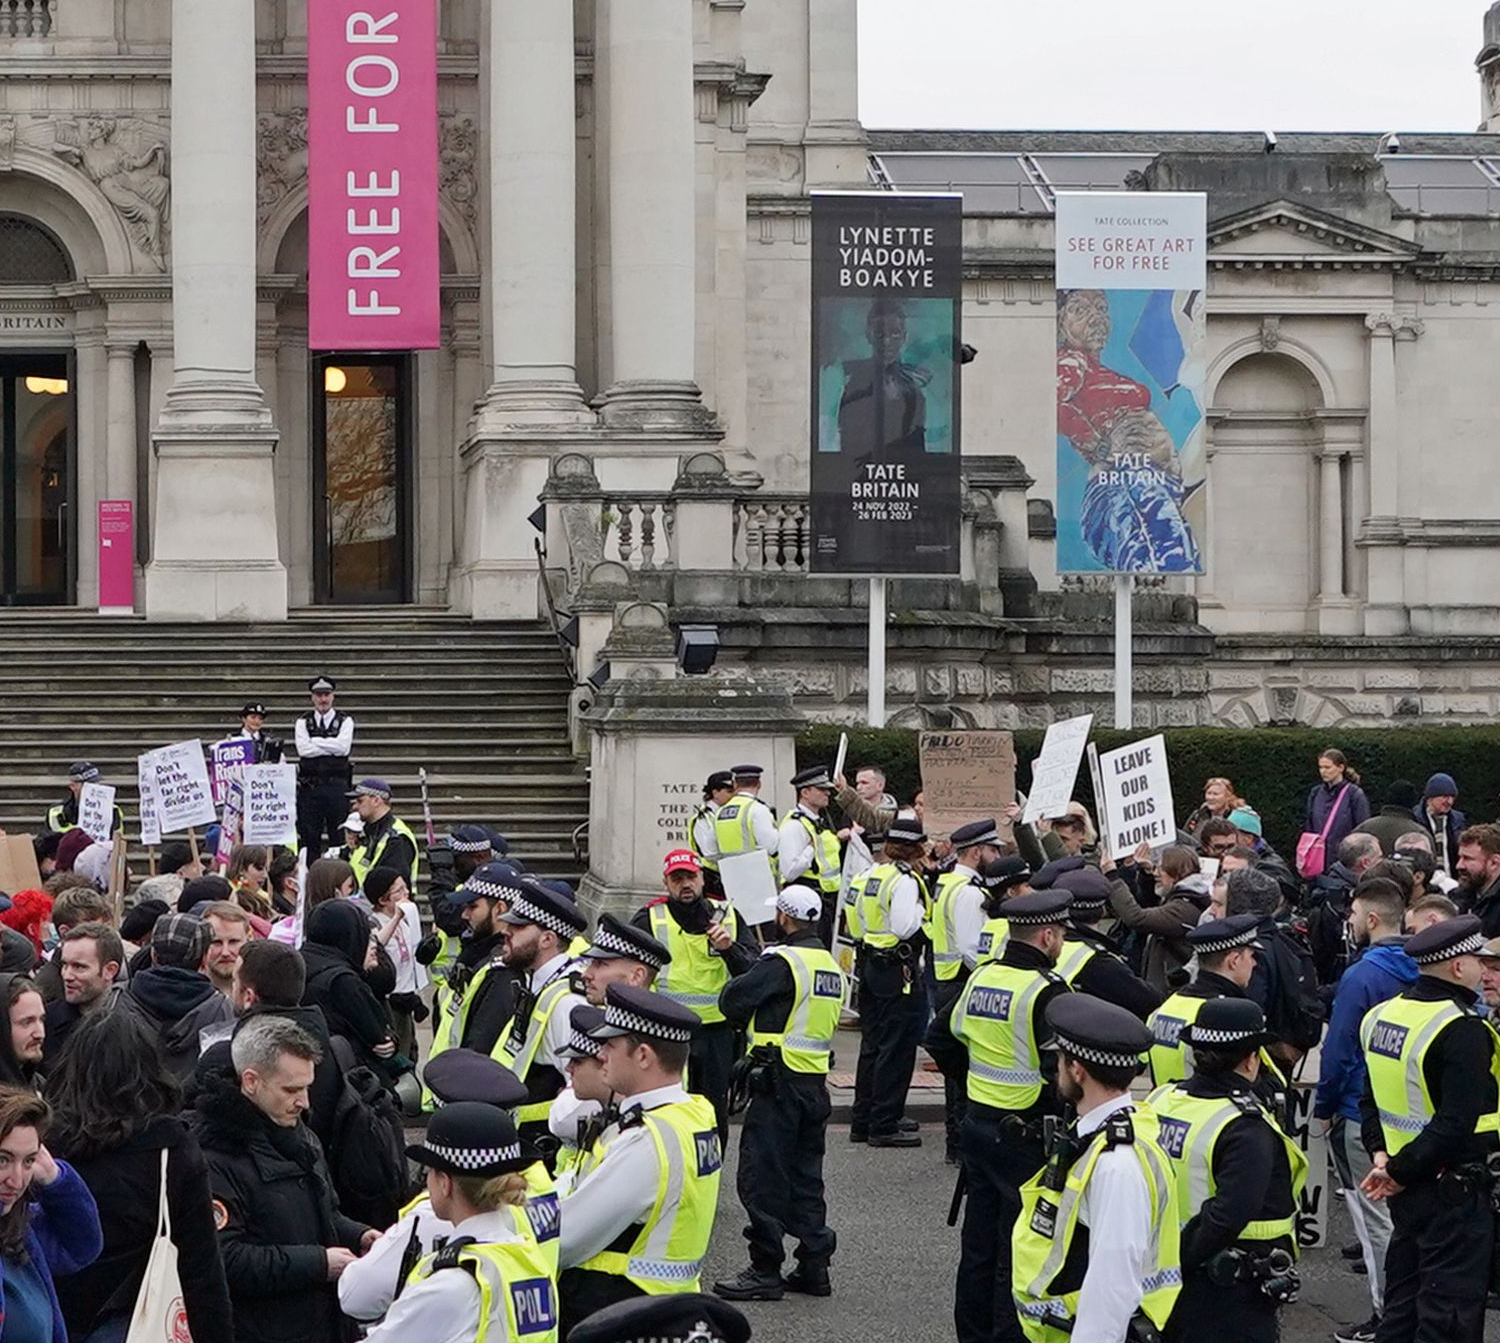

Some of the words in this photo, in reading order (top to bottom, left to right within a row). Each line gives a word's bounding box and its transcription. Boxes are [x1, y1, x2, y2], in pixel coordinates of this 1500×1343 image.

[346, 11, 399, 134] FOR
[1094, 217, 1113, 226] TATE
[1117, 217, 1169, 226] COLLECTION
[347, 169, 402, 317] FREE
[839, 227, 935, 246] LYNETTE
[1068, 238, 1095, 252] SEE
[1103, 238, 1155, 252] GREAT
[1163, 238, 1195, 252] ART
[839, 249, 935, 267] YIADOM-
[1093, 256, 1125, 270] FOR
[1132, 256, 1170, 270] FREE
[839, 269, 935, 287] BOAKYE
[1112, 453, 1152, 468] TATE
[866, 465, 905, 480] TATE
[1099, 471, 1166, 486] BRITAIN
[851, 482, 919, 498] BRITAIN
[853, 503, 863, 511] 24
[866, 502, 885, 511] NOV
[887, 502, 909, 511] 2022
[858, 511, 870, 519] 26
[872, 511, 887, 519] FEB
[889, 511, 912, 519] 2023
[214, 744, 245, 761] Trans
[155, 762, 181, 775] Don't
[1114, 747, 1152, 775] LEAVE
[158, 775, 173, 785] let
[174, 771, 188, 781] the
[251, 780, 275, 790] Don't
[161, 787, 173, 796] far
[174, 782, 200, 796] right
[662, 785, 697, 793] TATE
[1121, 775, 1149, 797] OUR
[163, 795, 191, 808] divide
[193, 792, 204, 801] us
[251, 791, 264, 800] let
[265, 791, 279, 800] the
[251, 803, 264, 811] far
[266, 801, 286, 814] right
[660, 805, 688, 813] THE
[1123, 798, 1156, 822] KIDS
[251, 813, 278, 822] divide
[279, 813, 289, 821] us
[969, 988, 1009, 1019] POLICE
[1155, 1016, 1181, 1044] POLICE
[1371, 1028, 1405, 1056] POLICE
[1161, 1122, 1185, 1156] ICE
